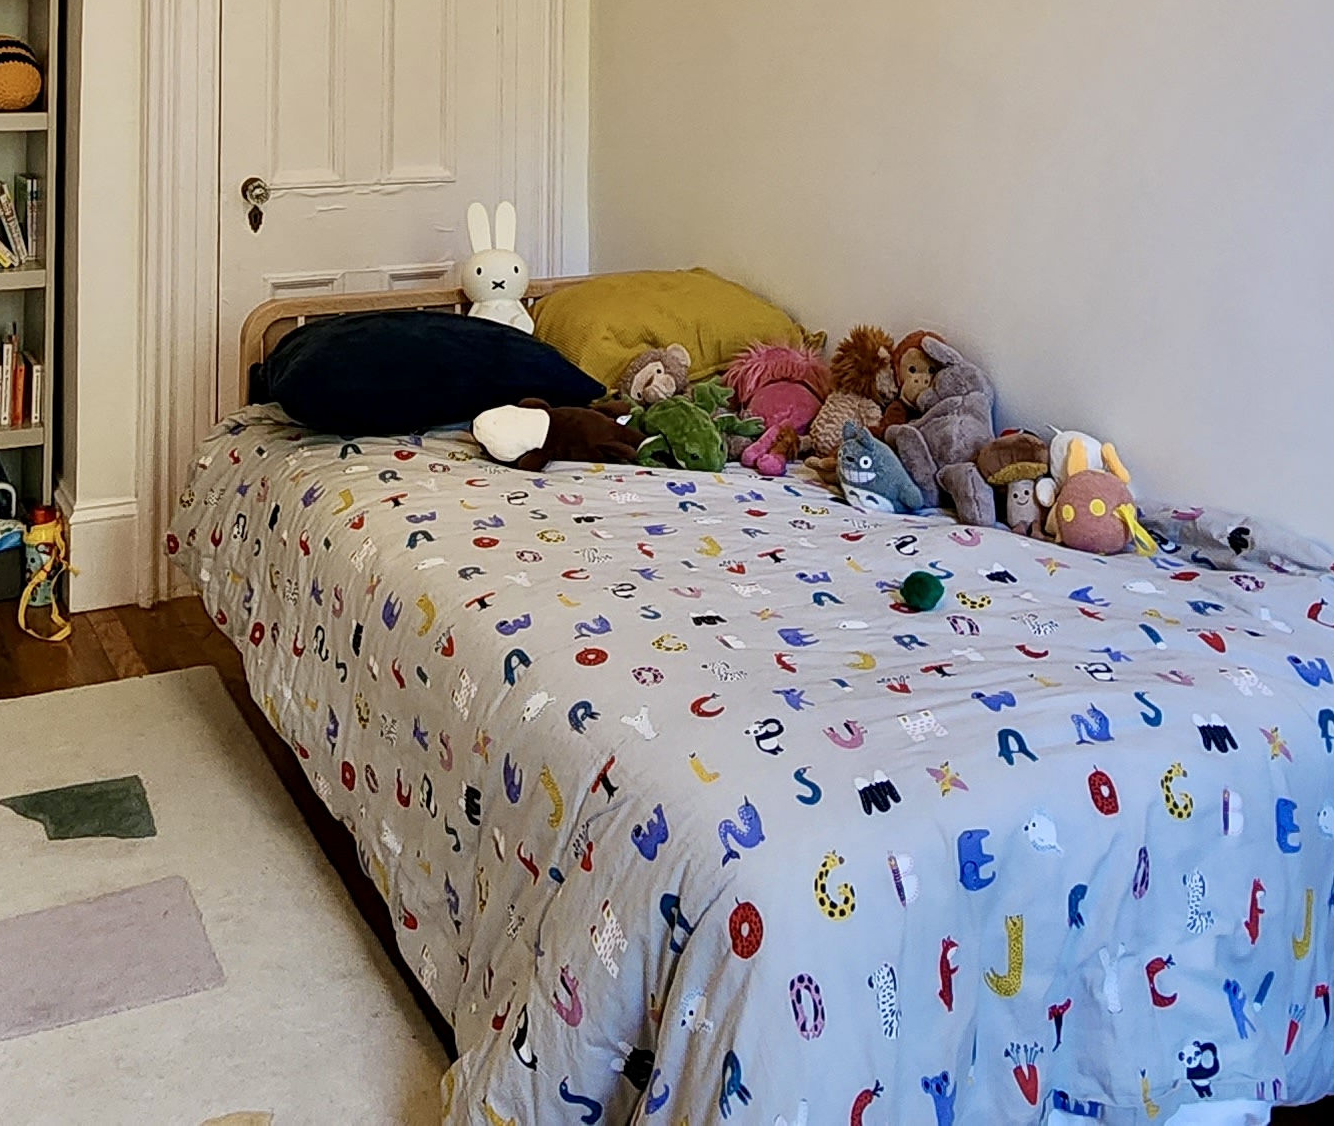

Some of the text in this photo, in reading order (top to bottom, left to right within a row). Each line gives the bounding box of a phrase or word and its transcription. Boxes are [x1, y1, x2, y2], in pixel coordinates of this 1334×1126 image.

[1134, 690, 1162, 727] S
[997, 728, 1039, 766] A
[794, 766, 822, 805] S
[1160, 762, 1194, 820] G
[1221, 783, 1244, 836] B
[1275, 797, 1302, 854] E
[813, 849, 856, 921] G
[957, 828, 996, 892] E
[1243, 877, 1266, 946] F
[938, 934, 961, 1012] F
[983, 914, 1024, 999] J
[1145, 953, 1178, 1008] C
